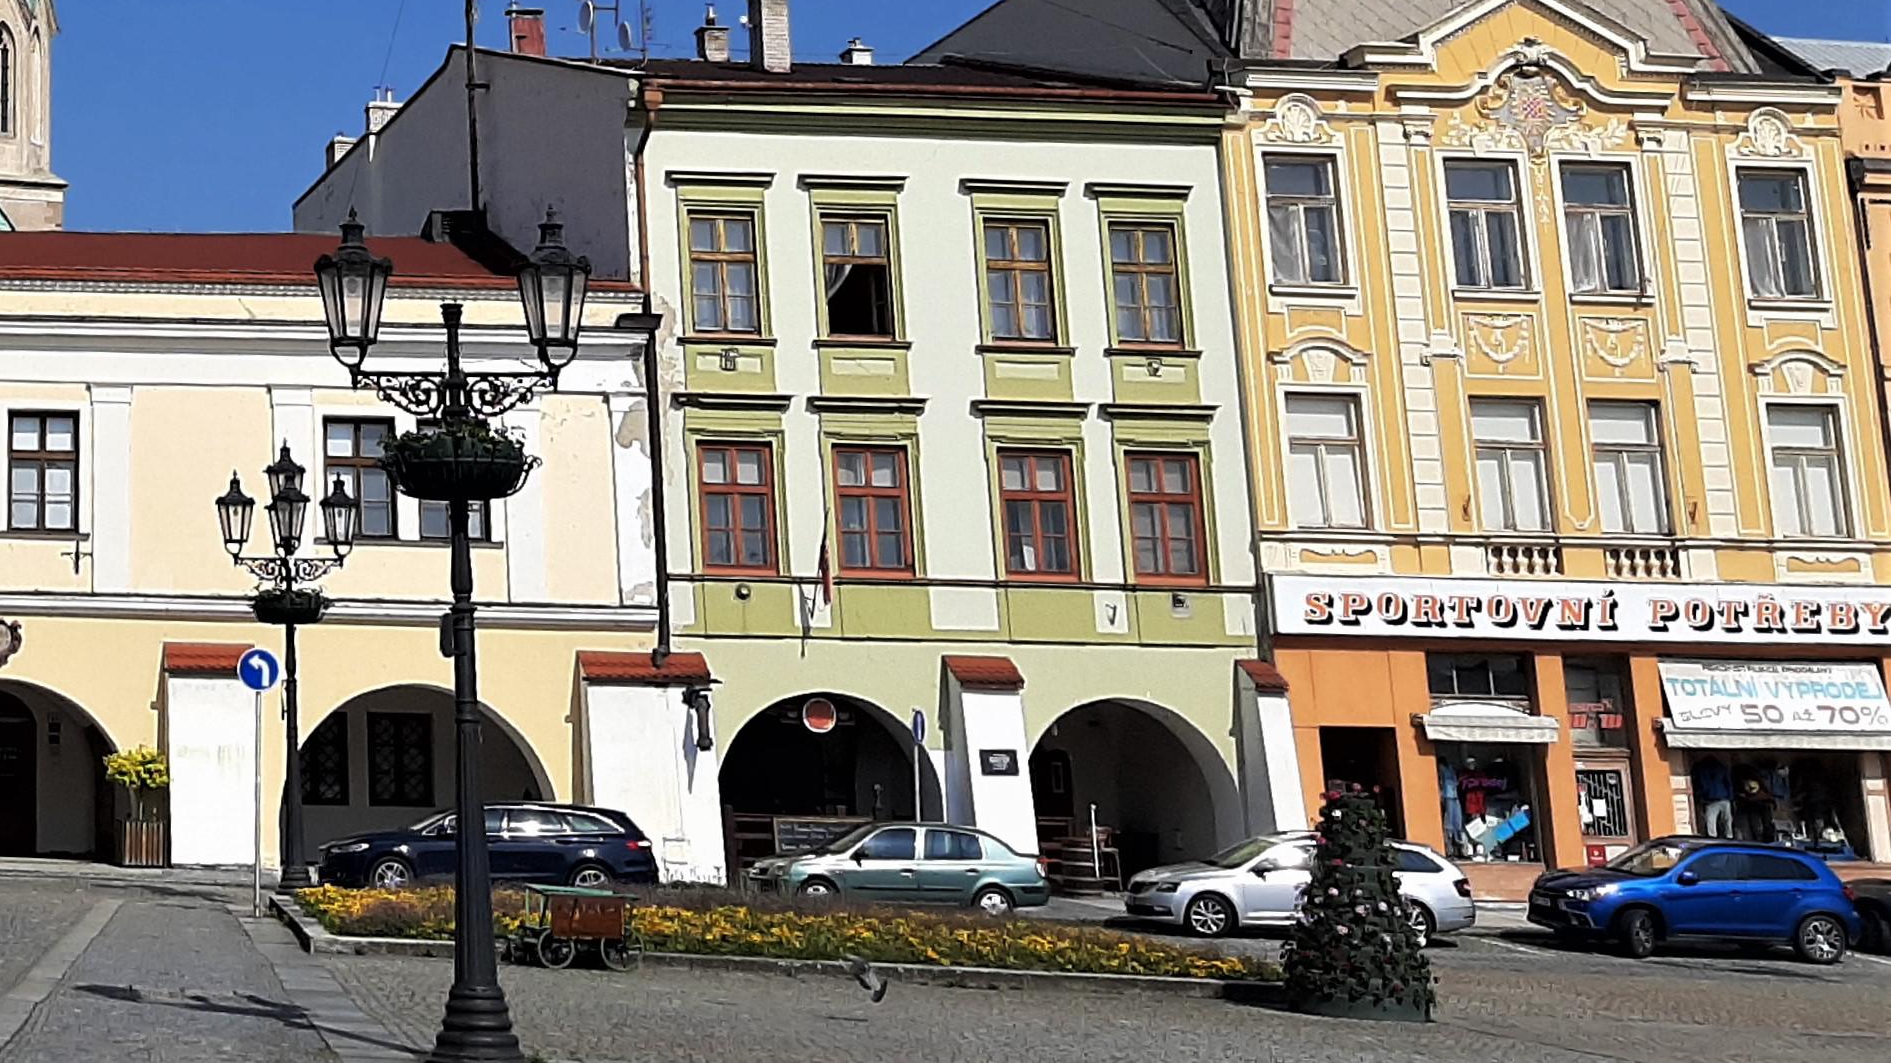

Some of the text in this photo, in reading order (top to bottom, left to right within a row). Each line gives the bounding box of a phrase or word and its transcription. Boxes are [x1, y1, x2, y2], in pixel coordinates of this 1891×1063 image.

[1303, 587, 1891, 635] SPORTOVNÍ POTŘEBY
[1740, 703, 1785, 724] 50
[1816, 704, 1889, 725] 70%
